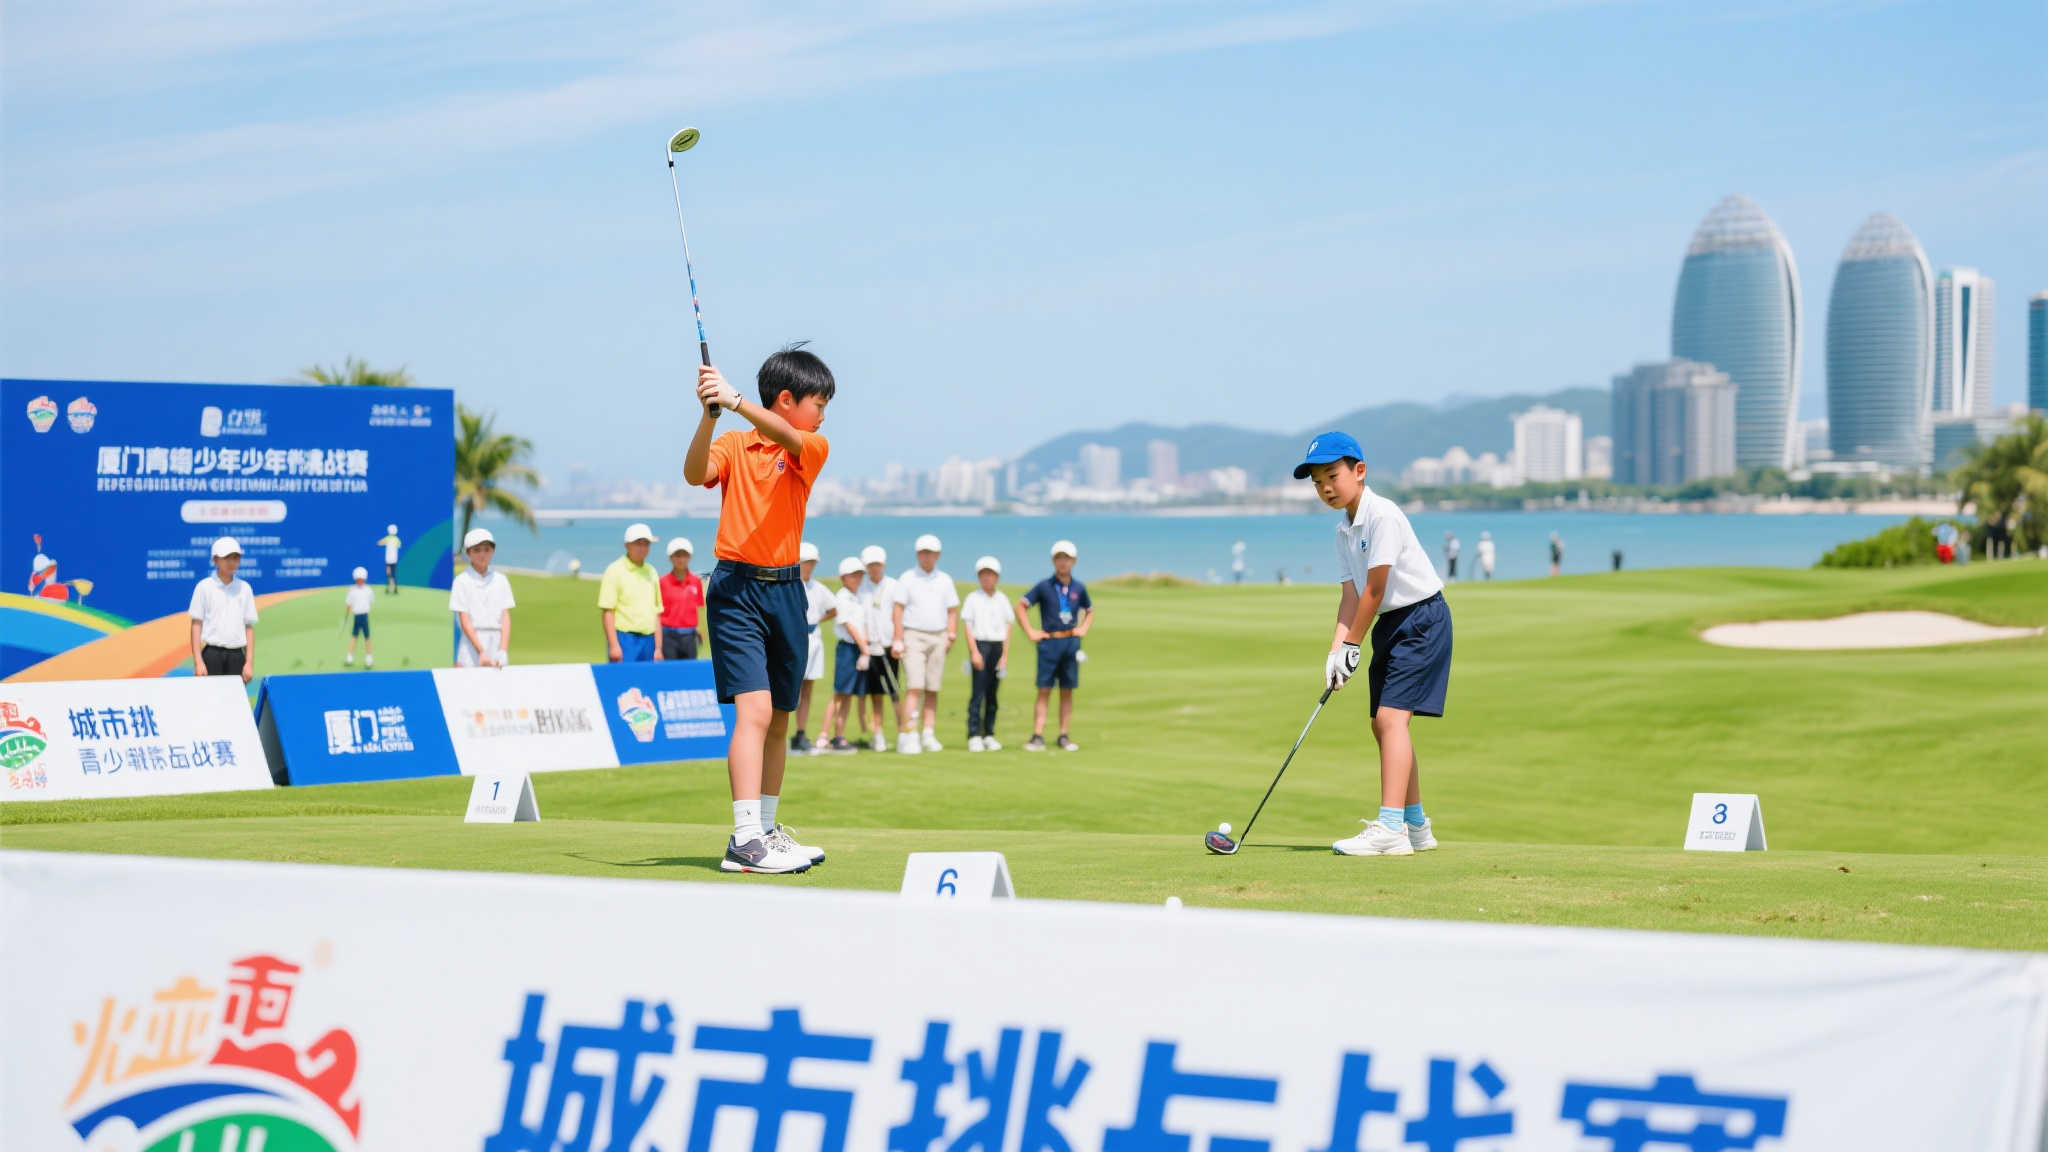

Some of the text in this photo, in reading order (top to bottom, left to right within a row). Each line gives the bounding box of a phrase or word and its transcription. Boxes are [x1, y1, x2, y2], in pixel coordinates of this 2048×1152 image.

[69, 704, 160, 741] 城市挑
[493, 781, 501, 801] 1
[1712, 802, 1728, 825] 3
[936, 867, 958, 897] 6
